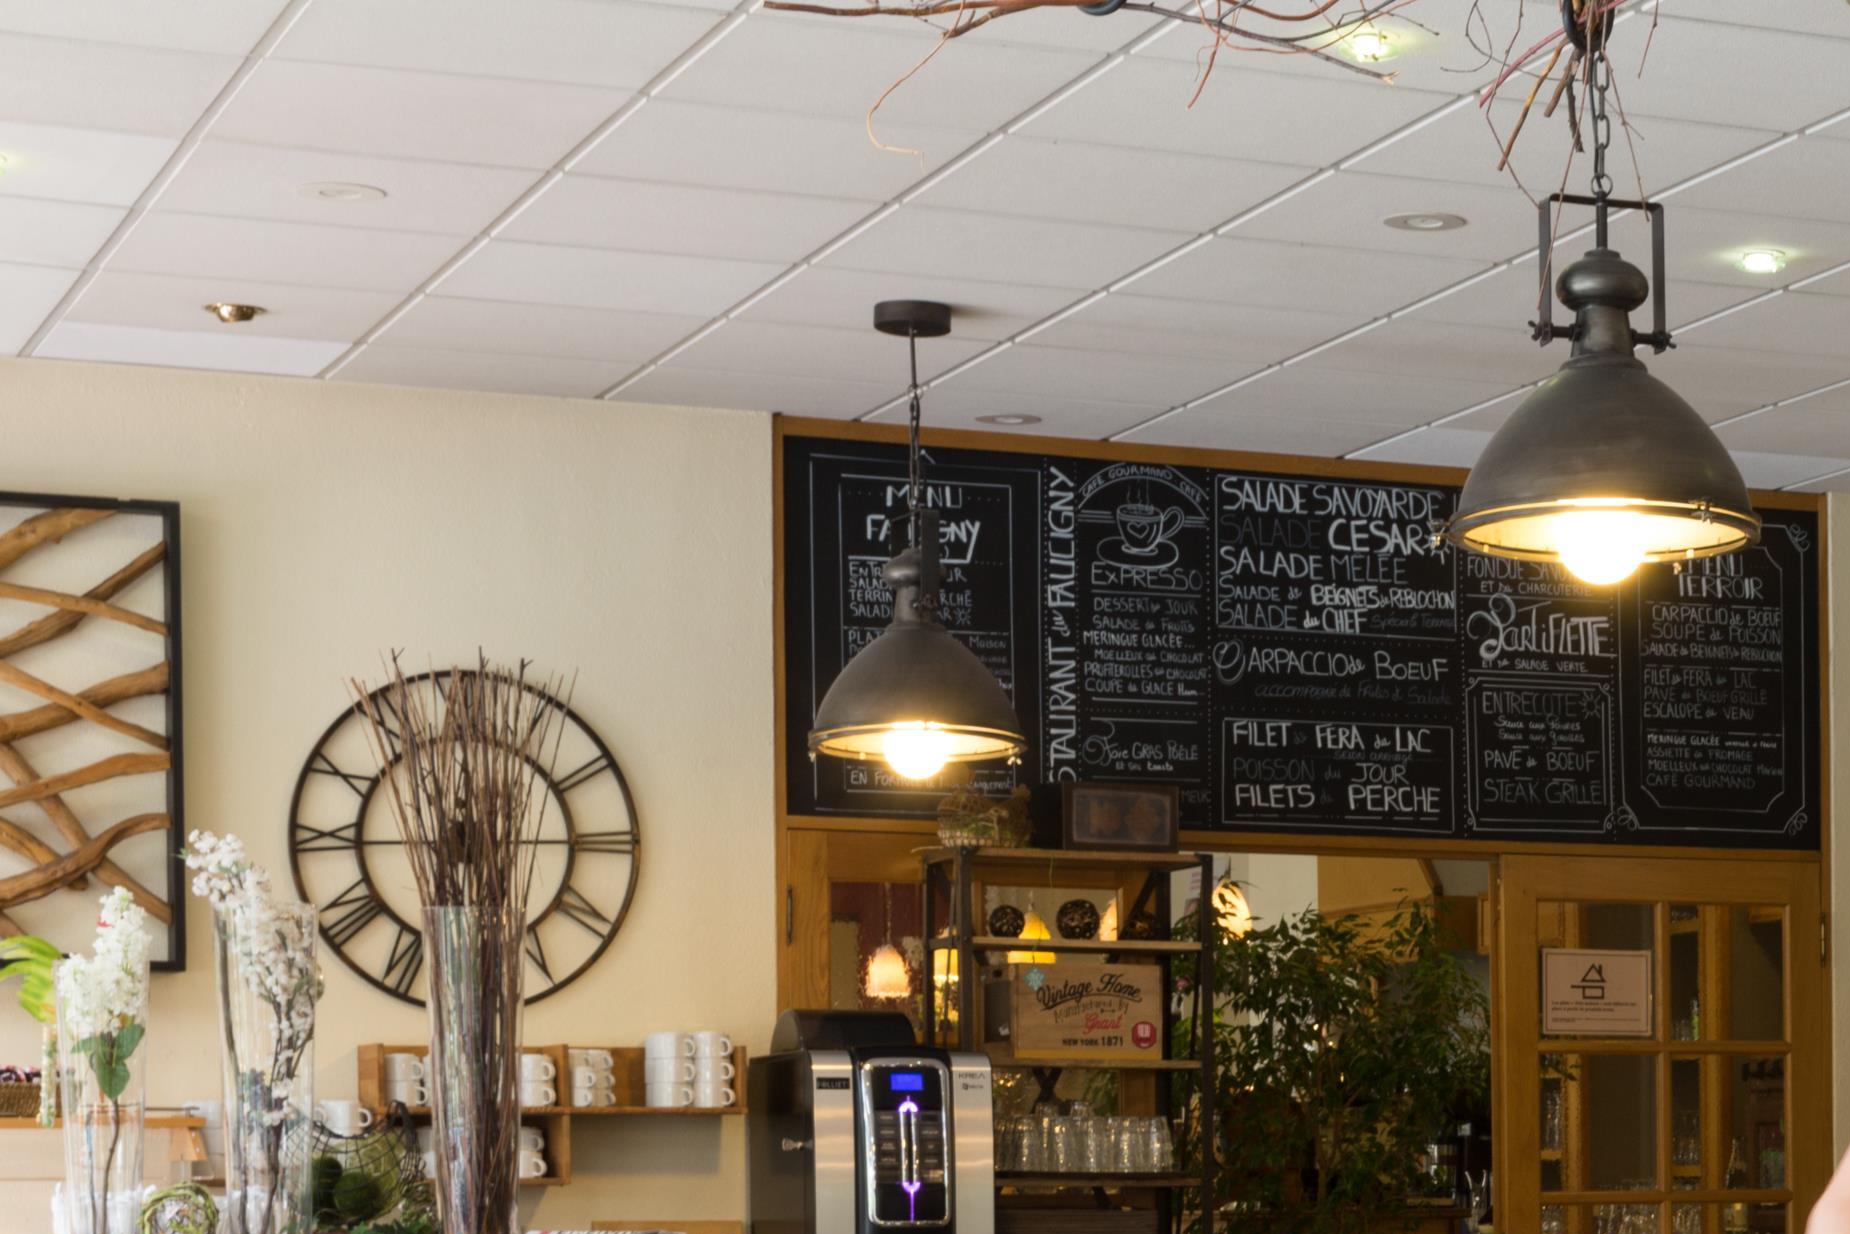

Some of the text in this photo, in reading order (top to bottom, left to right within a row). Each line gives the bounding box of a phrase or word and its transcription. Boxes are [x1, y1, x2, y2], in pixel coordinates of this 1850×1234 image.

[1221, 476, 1445, 522] SALADE SAVOYARDE
[866, 513, 980, 556] FAGNY
[1048, 466, 1076, 608] FAUCIGNY
[1219, 513, 1323, 549] SALADE
[1219, 545, 1325, 581] SALADE
[849, 577, 892, 591] SALAD
[849, 589, 893, 602] TERRIN
[1218, 574, 1281, 601] SALADE
[1678, 573, 1764, 600] TERROIR
[850, 602, 892, 618] SALAD
[1092, 614, 1141, 631] SALADE
[1218, 599, 1299, 630] SALADE
[1322, 607, 1369, 634] CHEF
[1083, 630, 1138, 647] MERINGUE
[1651, 622, 1706, 641] SOUPE
[1728, 626, 1782, 645] POISSON
[1374, 650, 1449, 682] BOEUF
[1682, 669, 1713, 687] FERA
[1049, 637, 1077, 783] STAURANT
[1643, 701, 1704, 720] ESCALOPE
[1233, 720, 1292, 748] FILET
[1315, 723, 1366, 750] FERA
[1394, 725, 1433, 753] LAC
[1232, 757, 1314, 782] POISSON
[1350, 762, 1410, 785] JOUR
[1545, 750, 1600, 772] BOEUF
[1483, 777, 1541, 804] STEAK
[1683, 773, 1757, 790] GOURMAND
[1234, 784, 1316, 809] FILETS
[1347, 784, 1441, 814] PERCHE
[1036, 973, 1143, 1008] Vintage Home
